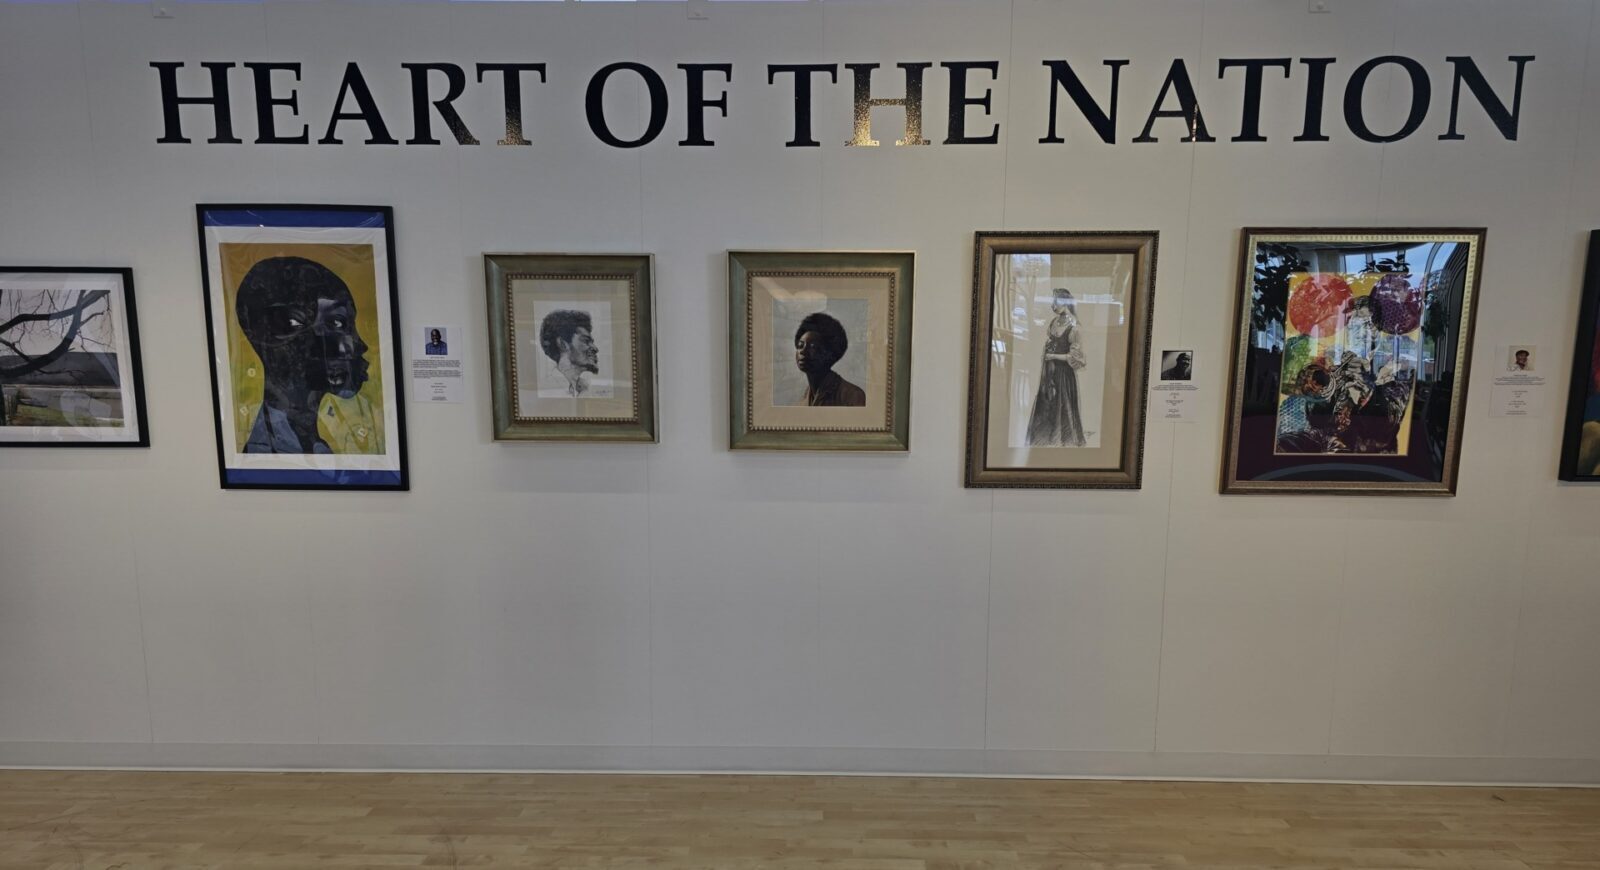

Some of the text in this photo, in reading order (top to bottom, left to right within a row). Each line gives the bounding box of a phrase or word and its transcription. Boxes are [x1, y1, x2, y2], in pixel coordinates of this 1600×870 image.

[149, 56, 1535, 148] HEART OF THE NATION
